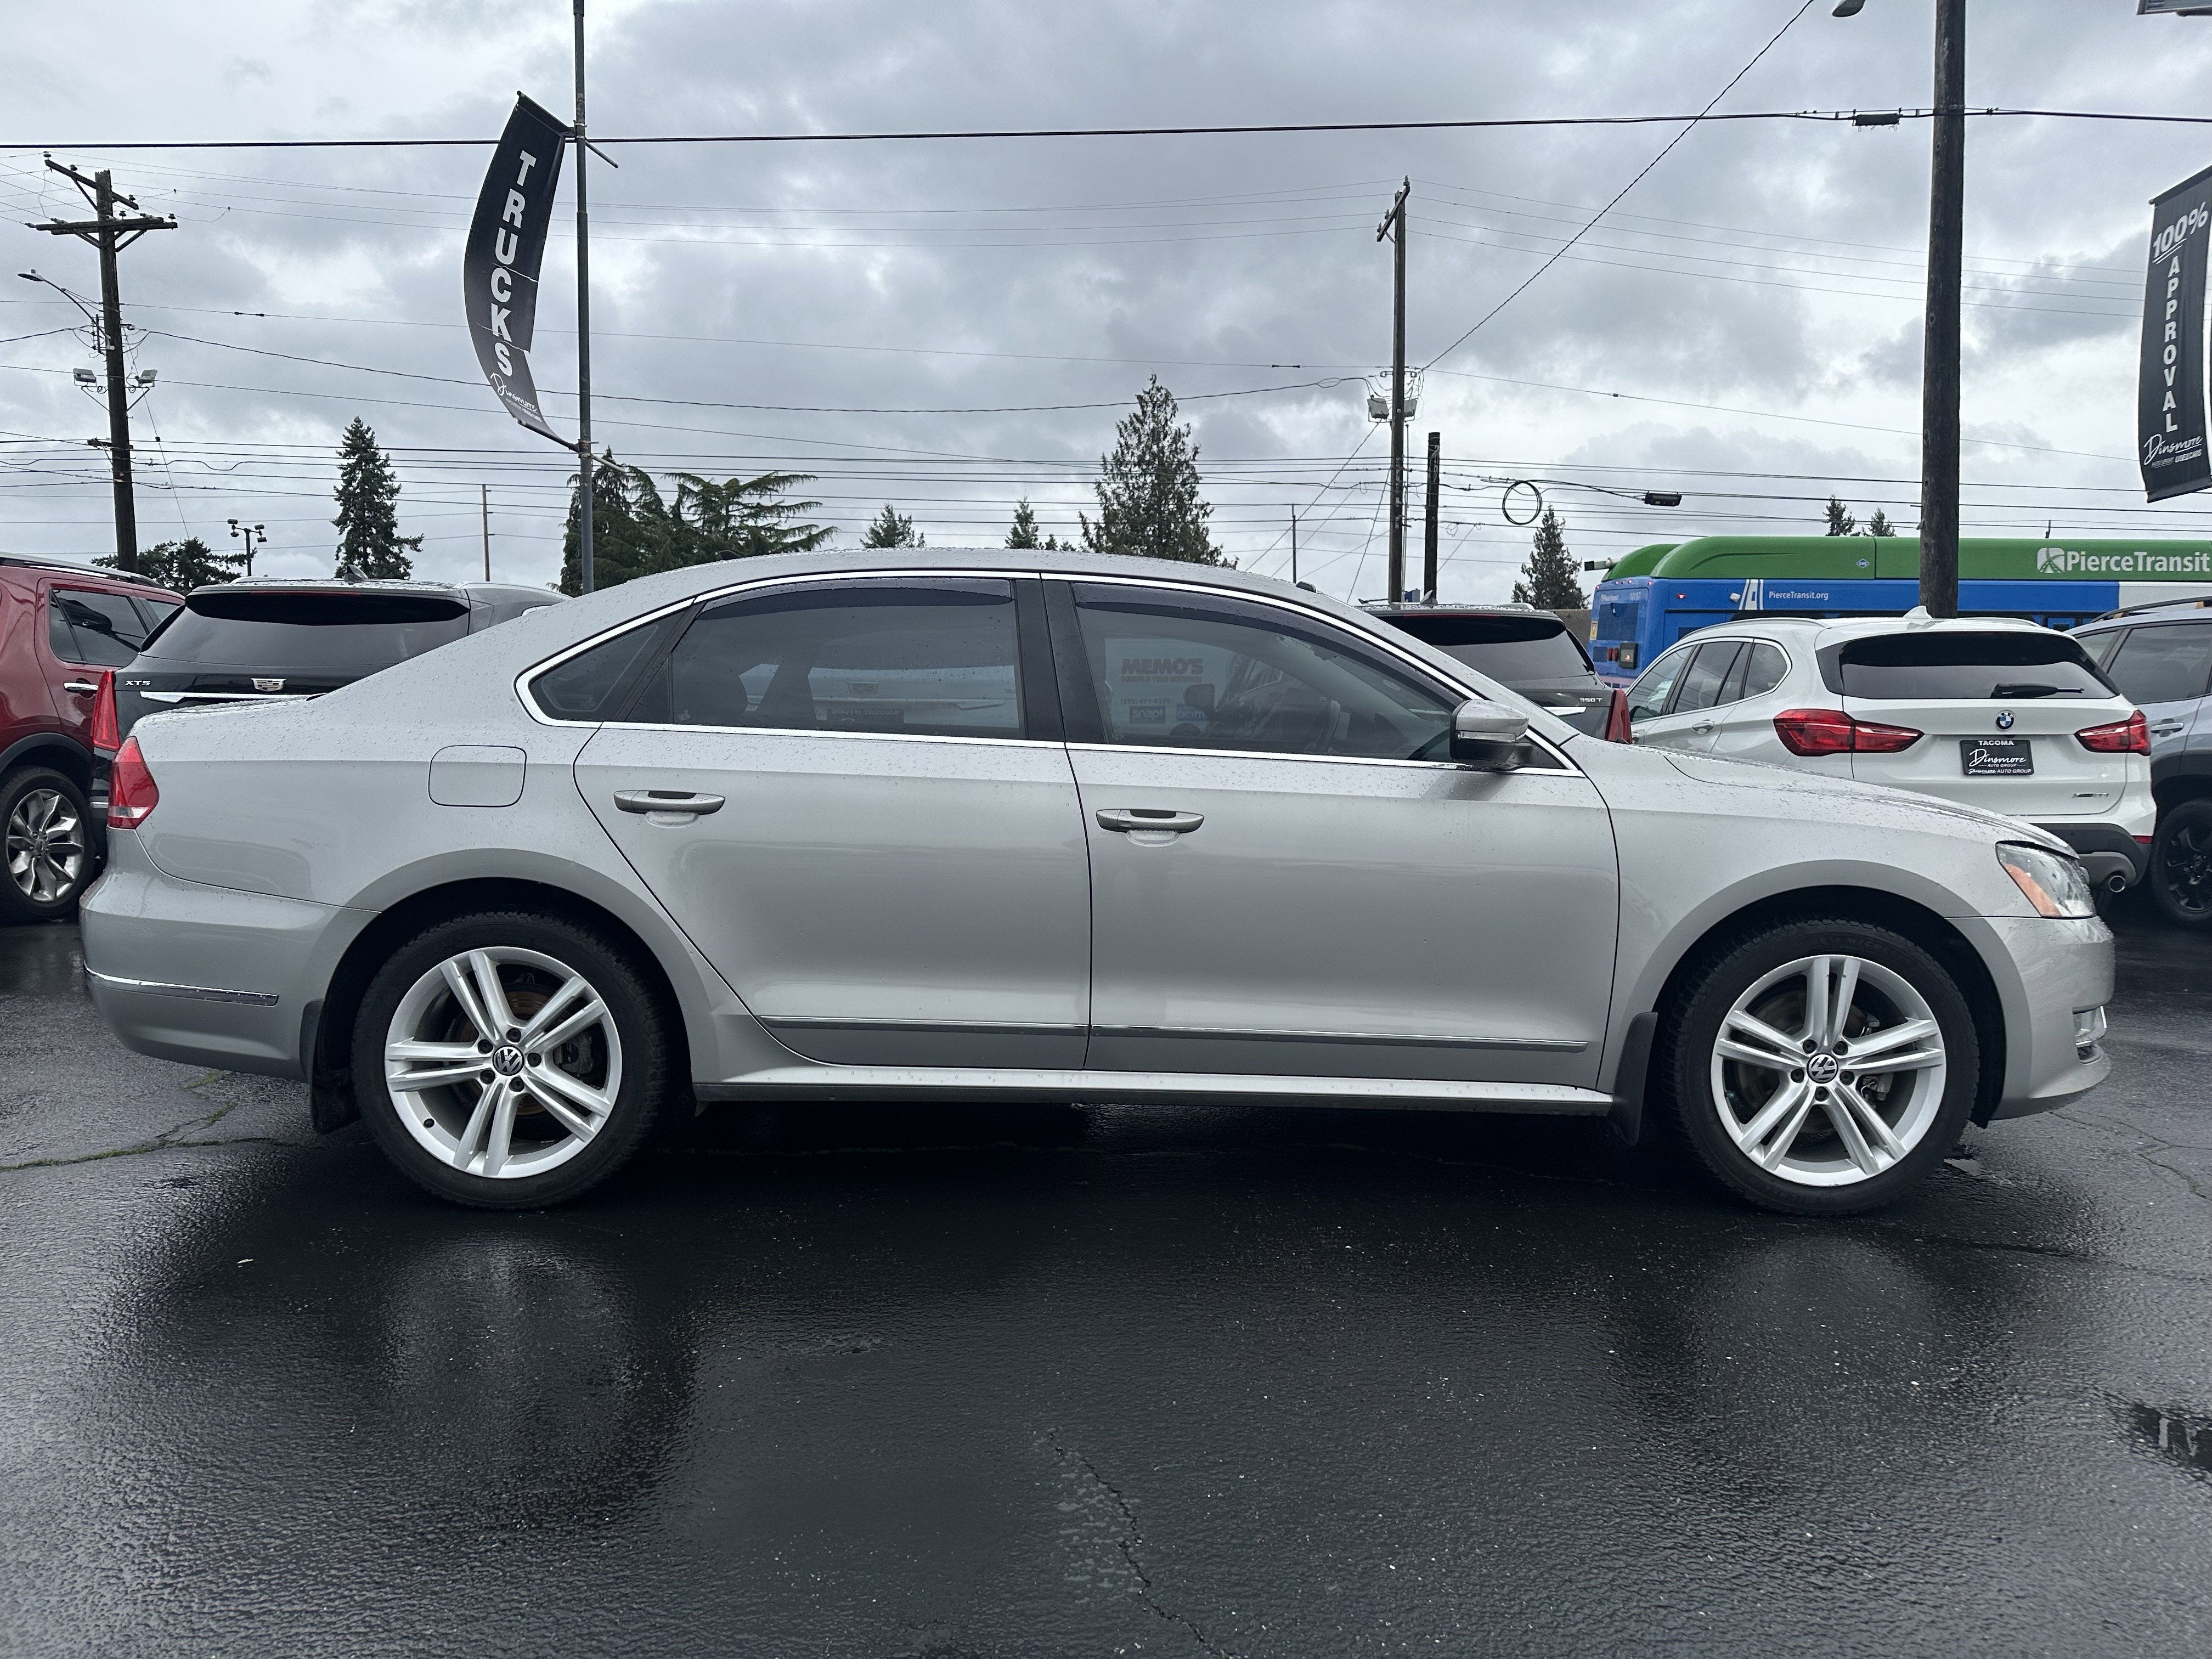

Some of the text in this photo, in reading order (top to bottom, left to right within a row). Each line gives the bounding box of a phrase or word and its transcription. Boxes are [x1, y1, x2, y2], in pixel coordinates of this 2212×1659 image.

[2153, 201, 2209, 258] 100%
[491, 150, 537, 376] TRUCKS
[2162, 256, 2180, 433] APPROVAL
[2143, 433, 2203, 466] Dinsmore
[2067, 551, 2211, 572] PierceTransit
[1768, 590, 1829, 601] PierceTransit.org
[1121, 658, 1204, 675] MEMO'S
[1177, 710, 1207, 719] acim
[1968, 748, 2027, 767] Dinsmore
